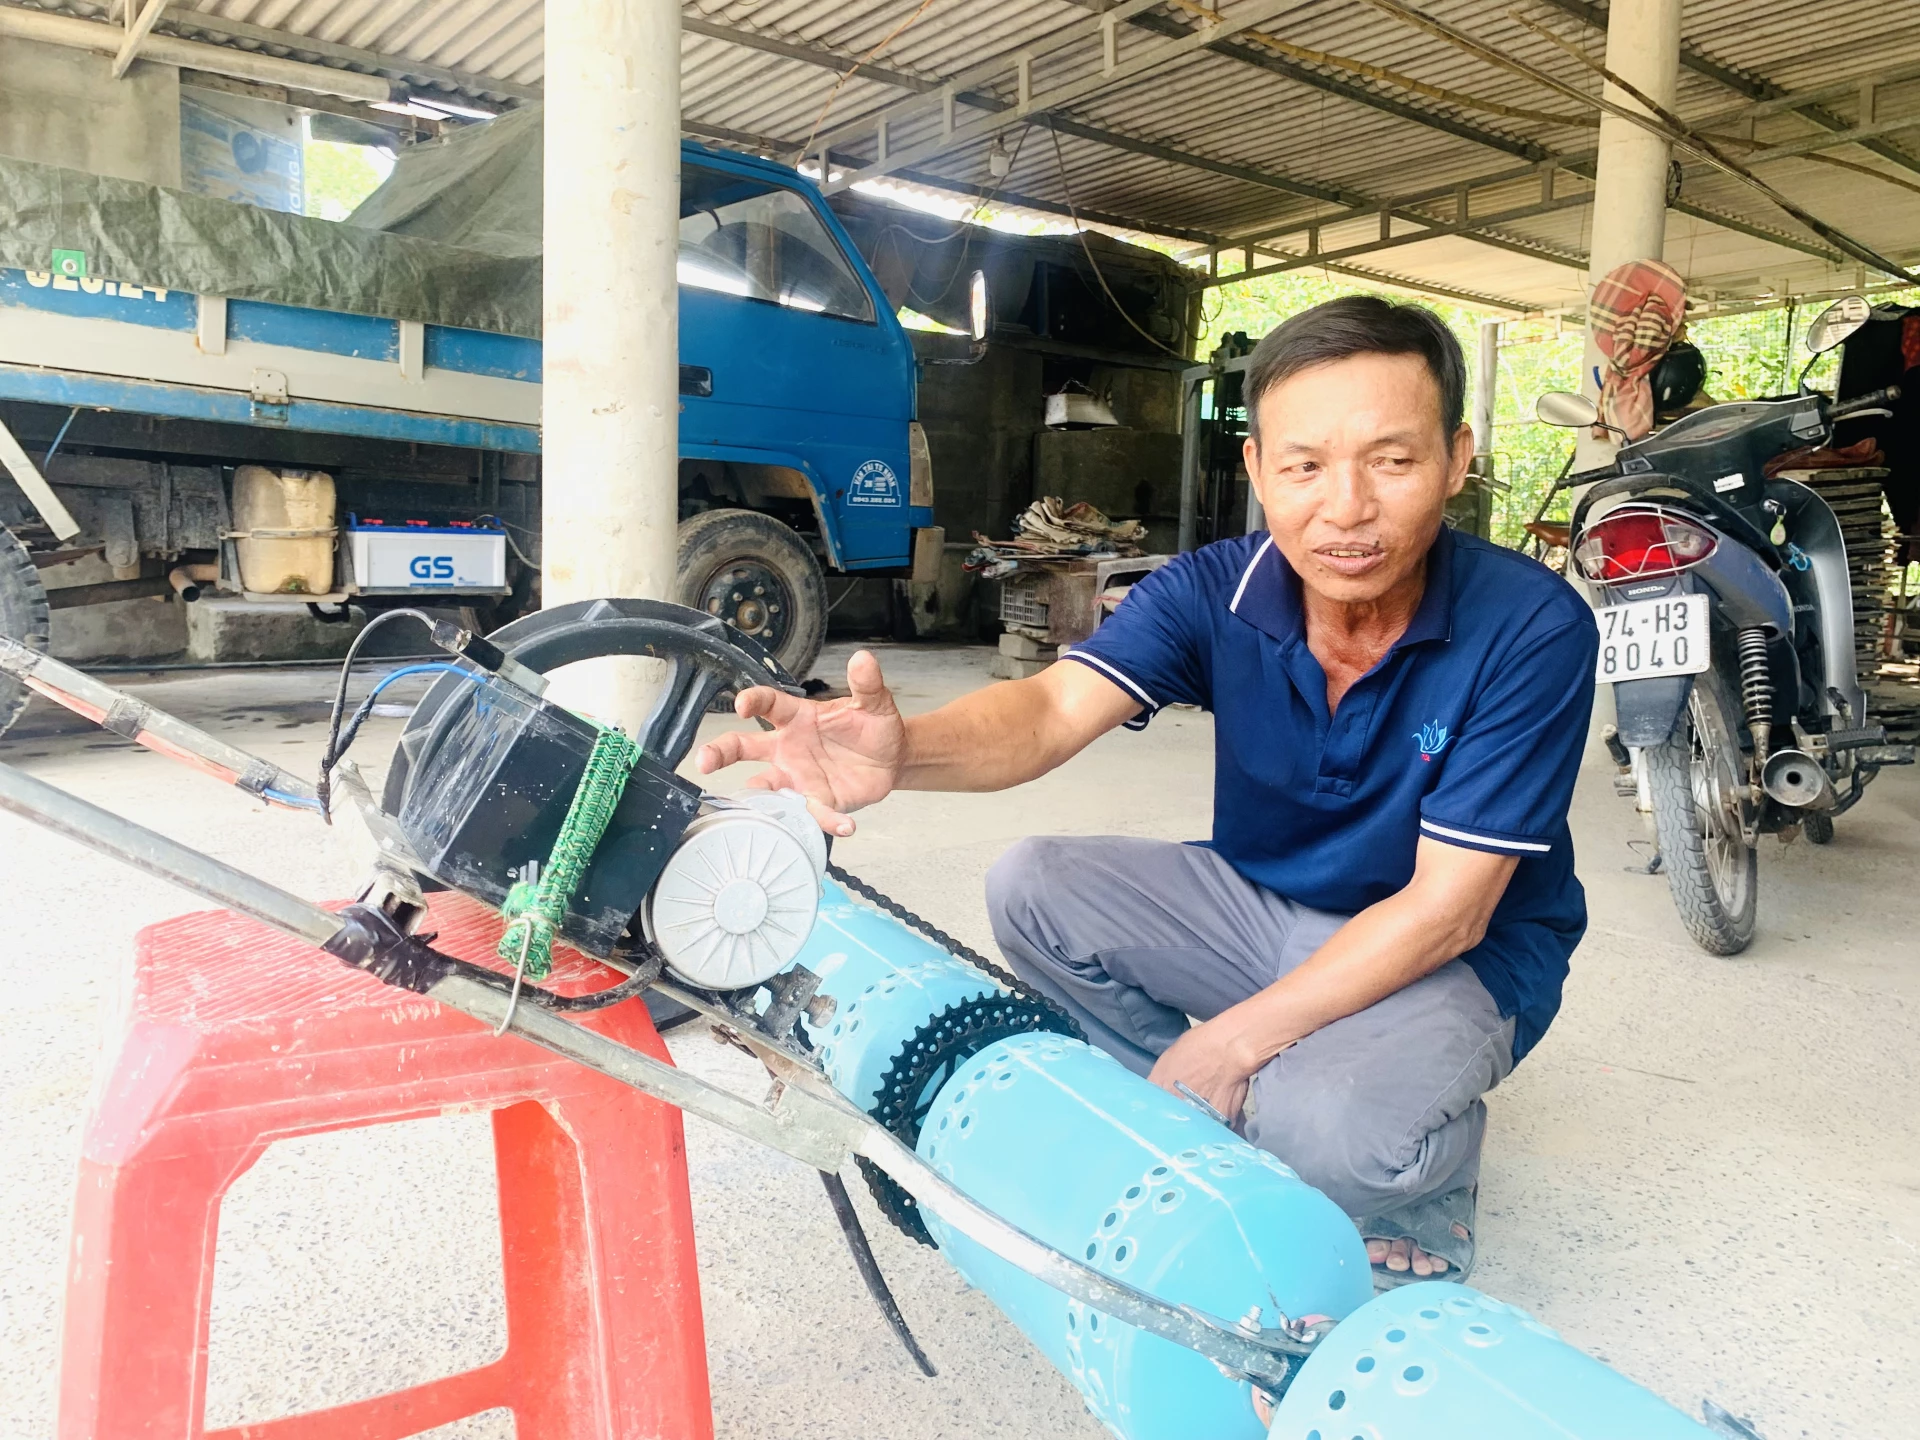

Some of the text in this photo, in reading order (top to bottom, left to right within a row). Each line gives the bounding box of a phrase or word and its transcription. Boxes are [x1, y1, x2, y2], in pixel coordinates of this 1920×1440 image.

[410, 556, 454, 578] GS
[1628, 585, 1667, 596] HONDA
[1604, 602, 1688, 640] 74-H3
[1604, 636, 1688, 674] 8040
